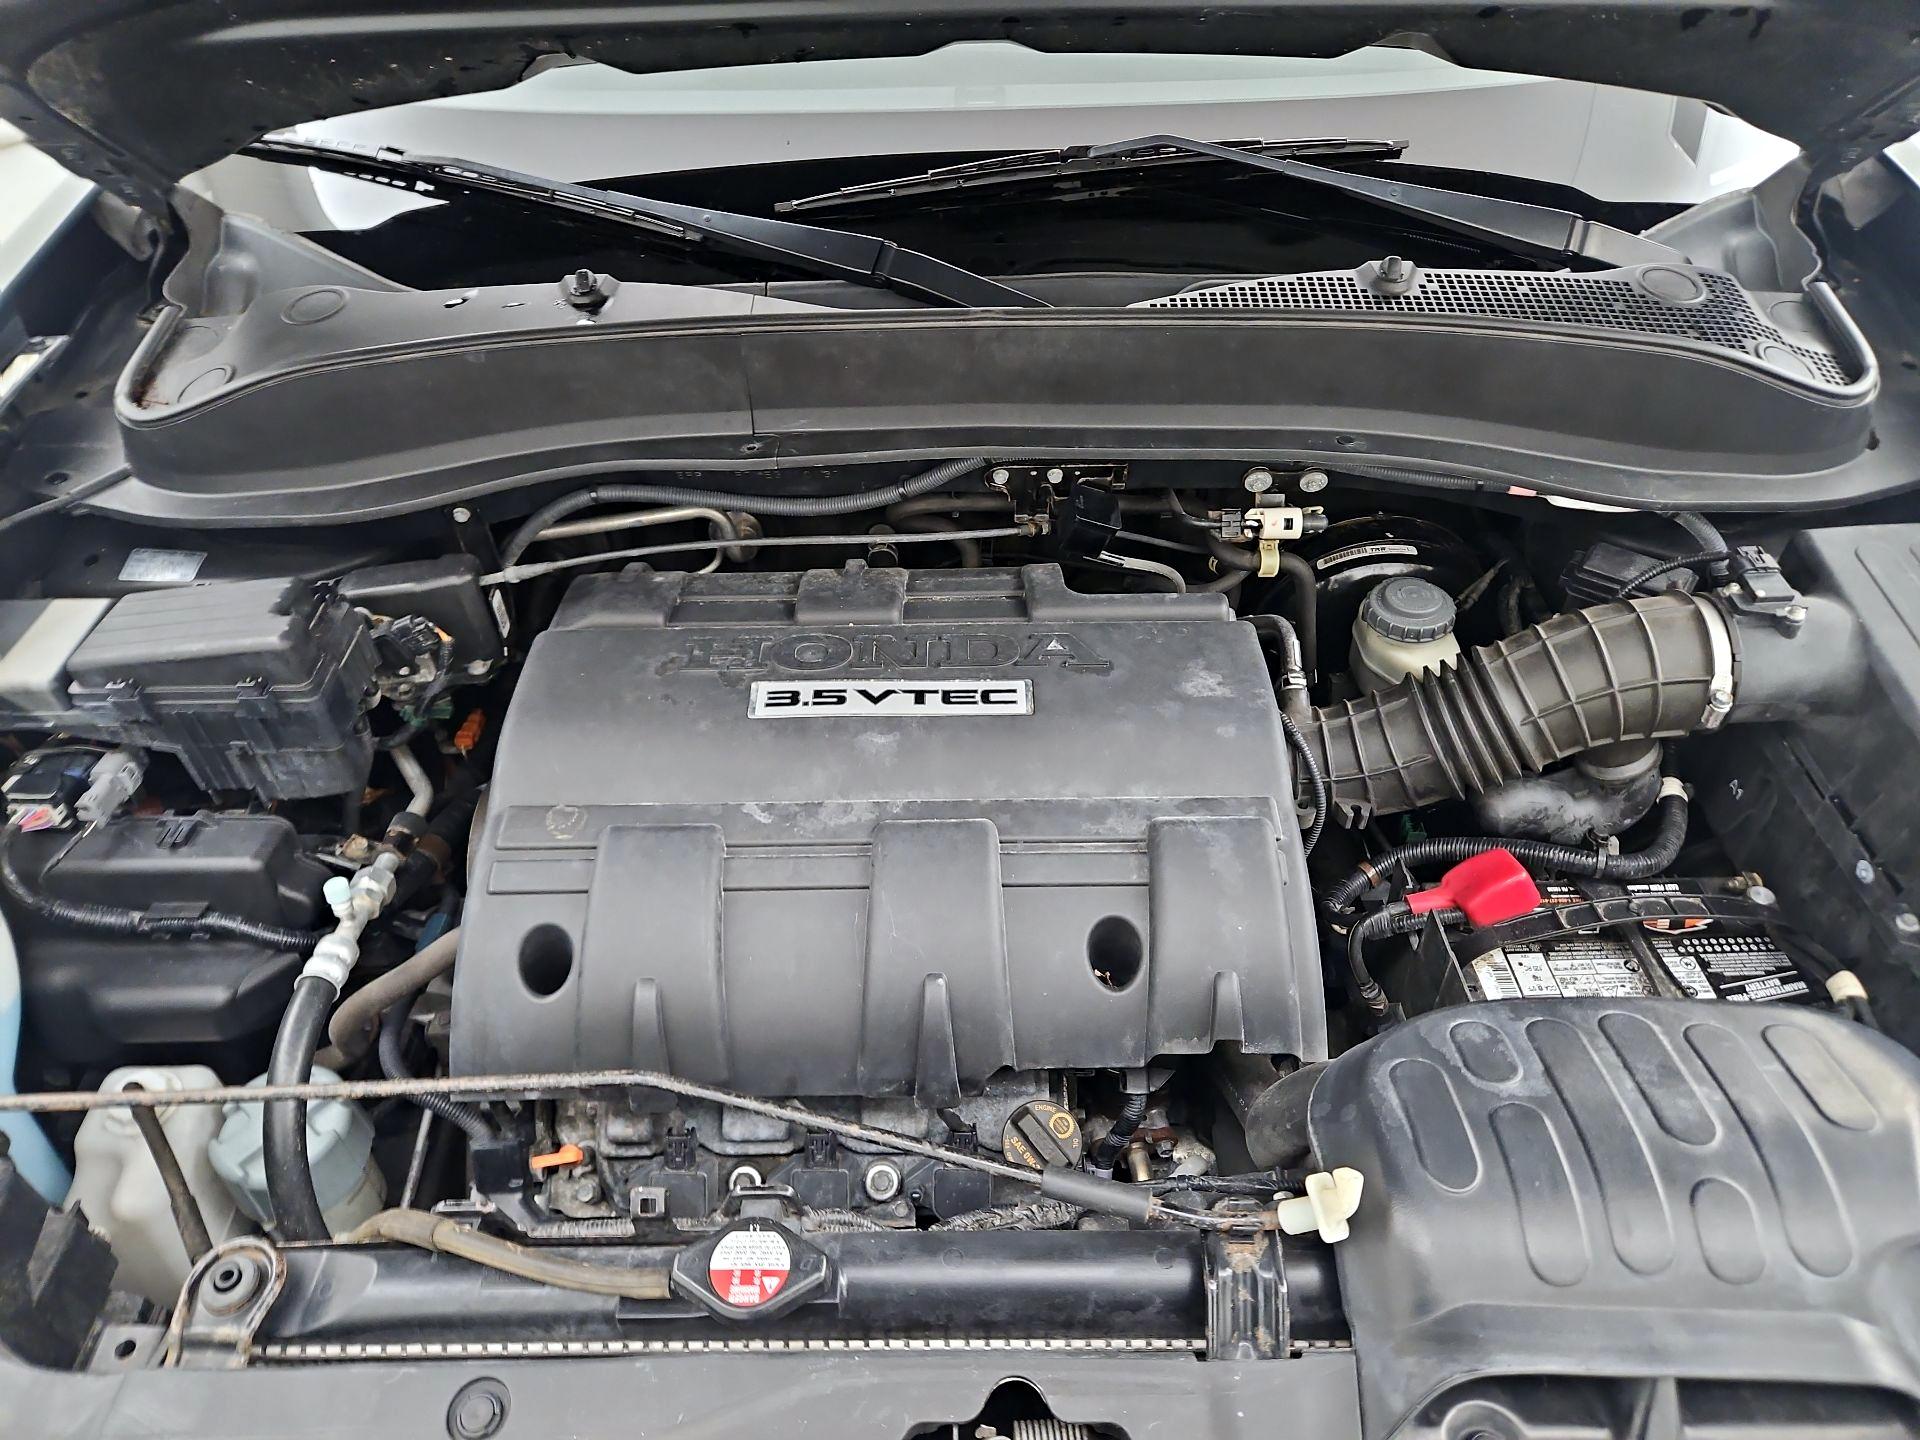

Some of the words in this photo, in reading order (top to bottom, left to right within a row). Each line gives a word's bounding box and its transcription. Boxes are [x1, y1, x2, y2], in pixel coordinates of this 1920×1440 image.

[680, 633, 1110, 671] HONDA
[764, 690, 847, 707] 3.5
[853, 689, 1018, 706] VTEC
[1744, 977, 1782, 992] BATTERY
[1034, 1104, 1057, 1112] ENGINE
[1010, 1136, 1026, 1154] SAE
